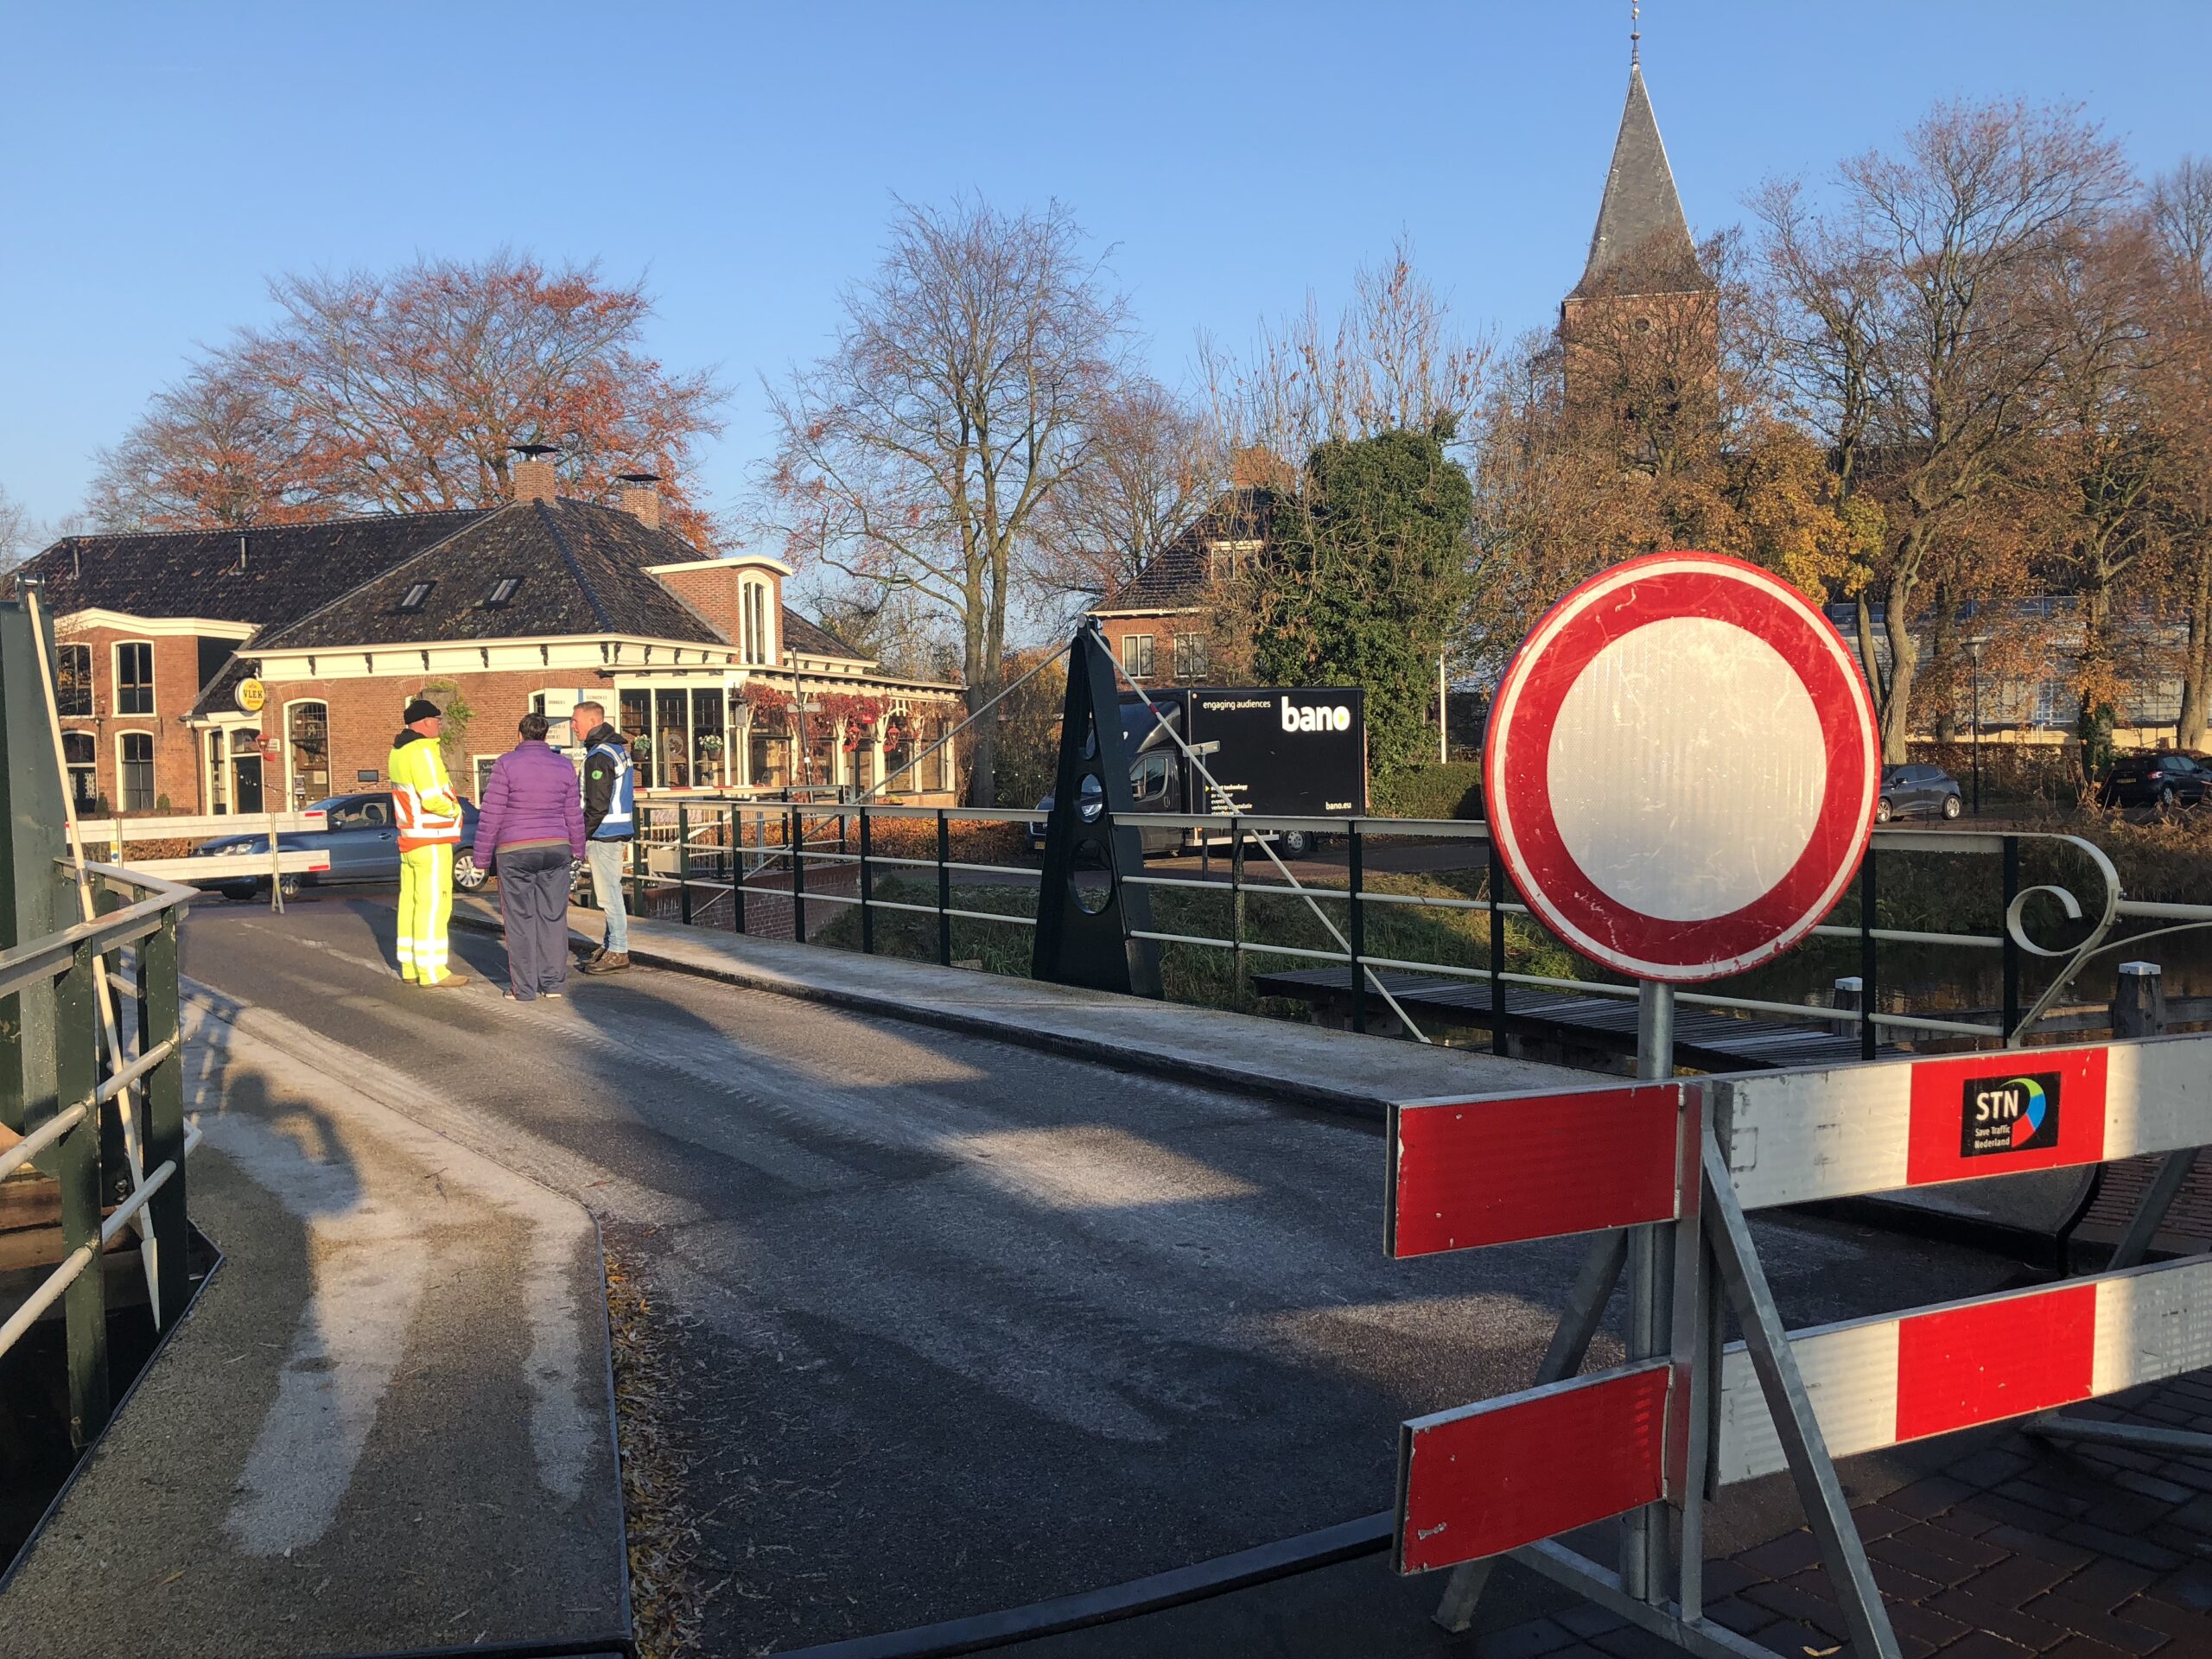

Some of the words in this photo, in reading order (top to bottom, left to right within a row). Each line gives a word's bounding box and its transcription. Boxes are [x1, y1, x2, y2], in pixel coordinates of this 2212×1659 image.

[243, 690, 263, 699] VLEK
[1203, 699, 1236, 711] engaging
[1236, 698, 1271, 709] audiences
[1281, 696, 1351, 732] bano
[1325, 801, 1351, 810] bano.eu
[1975, 1090, 2018, 1122] STN
[1975, 1128, 1990, 1137] Save
[1991, 1124, 2011, 1135] Traffic
[1974, 1137, 2010, 1149] Nederland
